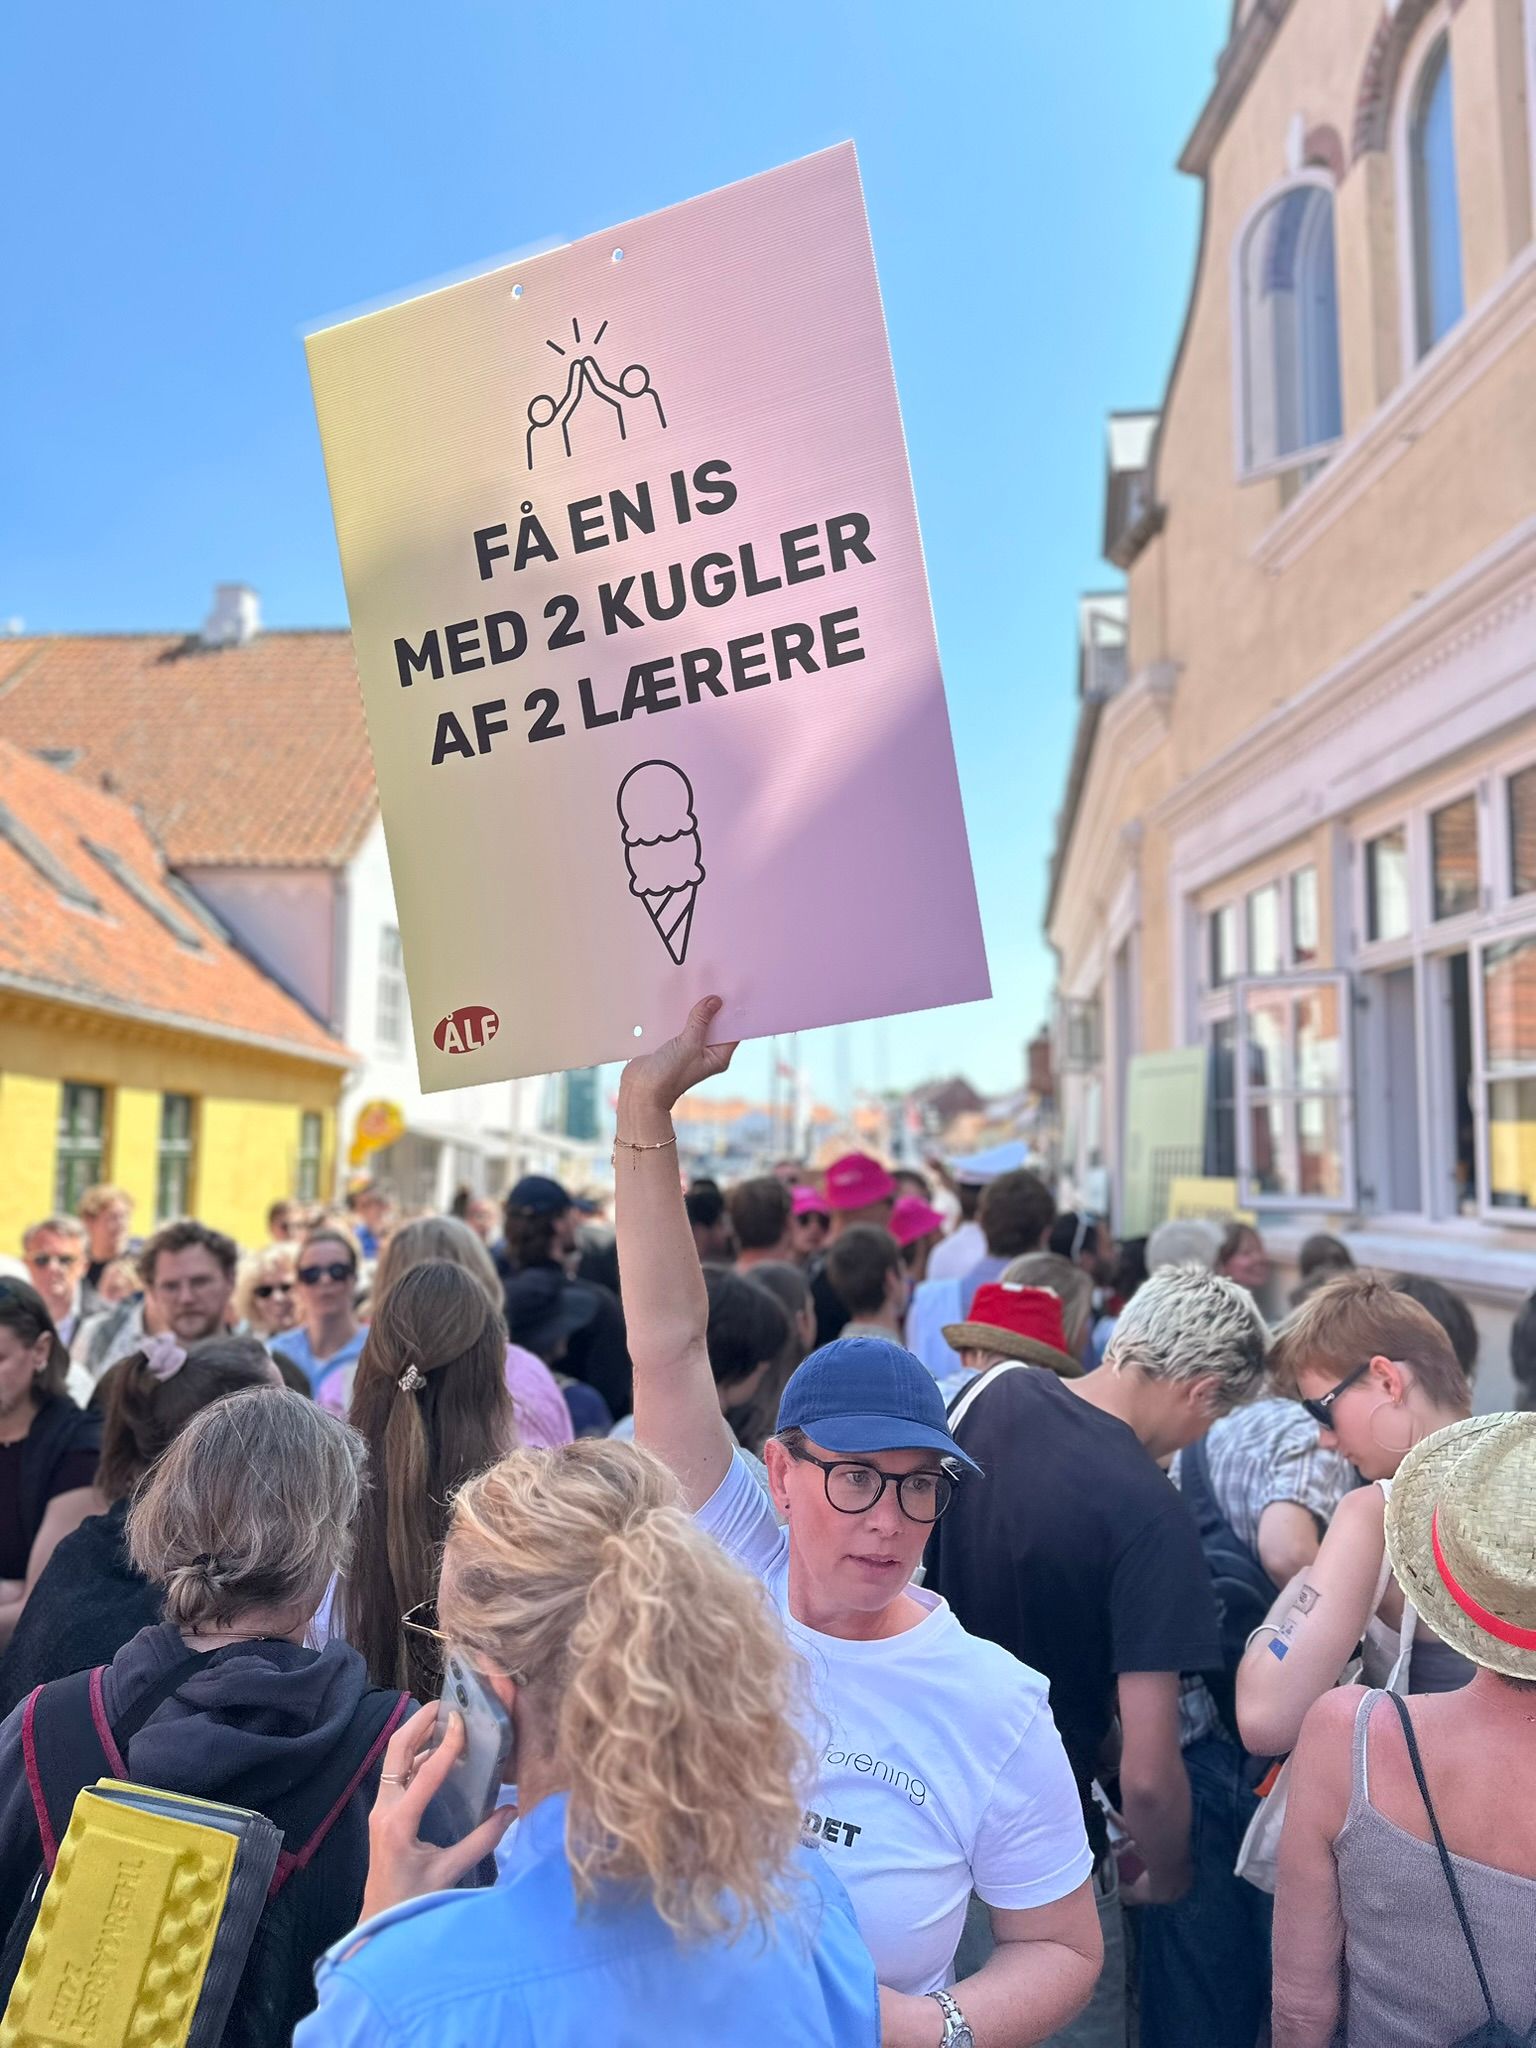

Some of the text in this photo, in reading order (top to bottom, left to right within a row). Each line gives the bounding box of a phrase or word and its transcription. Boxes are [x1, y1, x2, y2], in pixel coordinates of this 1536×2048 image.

[474, 459, 738, 580] FÅ EN IS
[394, 512, 877, 688] MED 2 KUGLER
[432, 606, 866, 766] AF 2 LÆRERE
[443, 1012, 496, 1053] ÅLF
